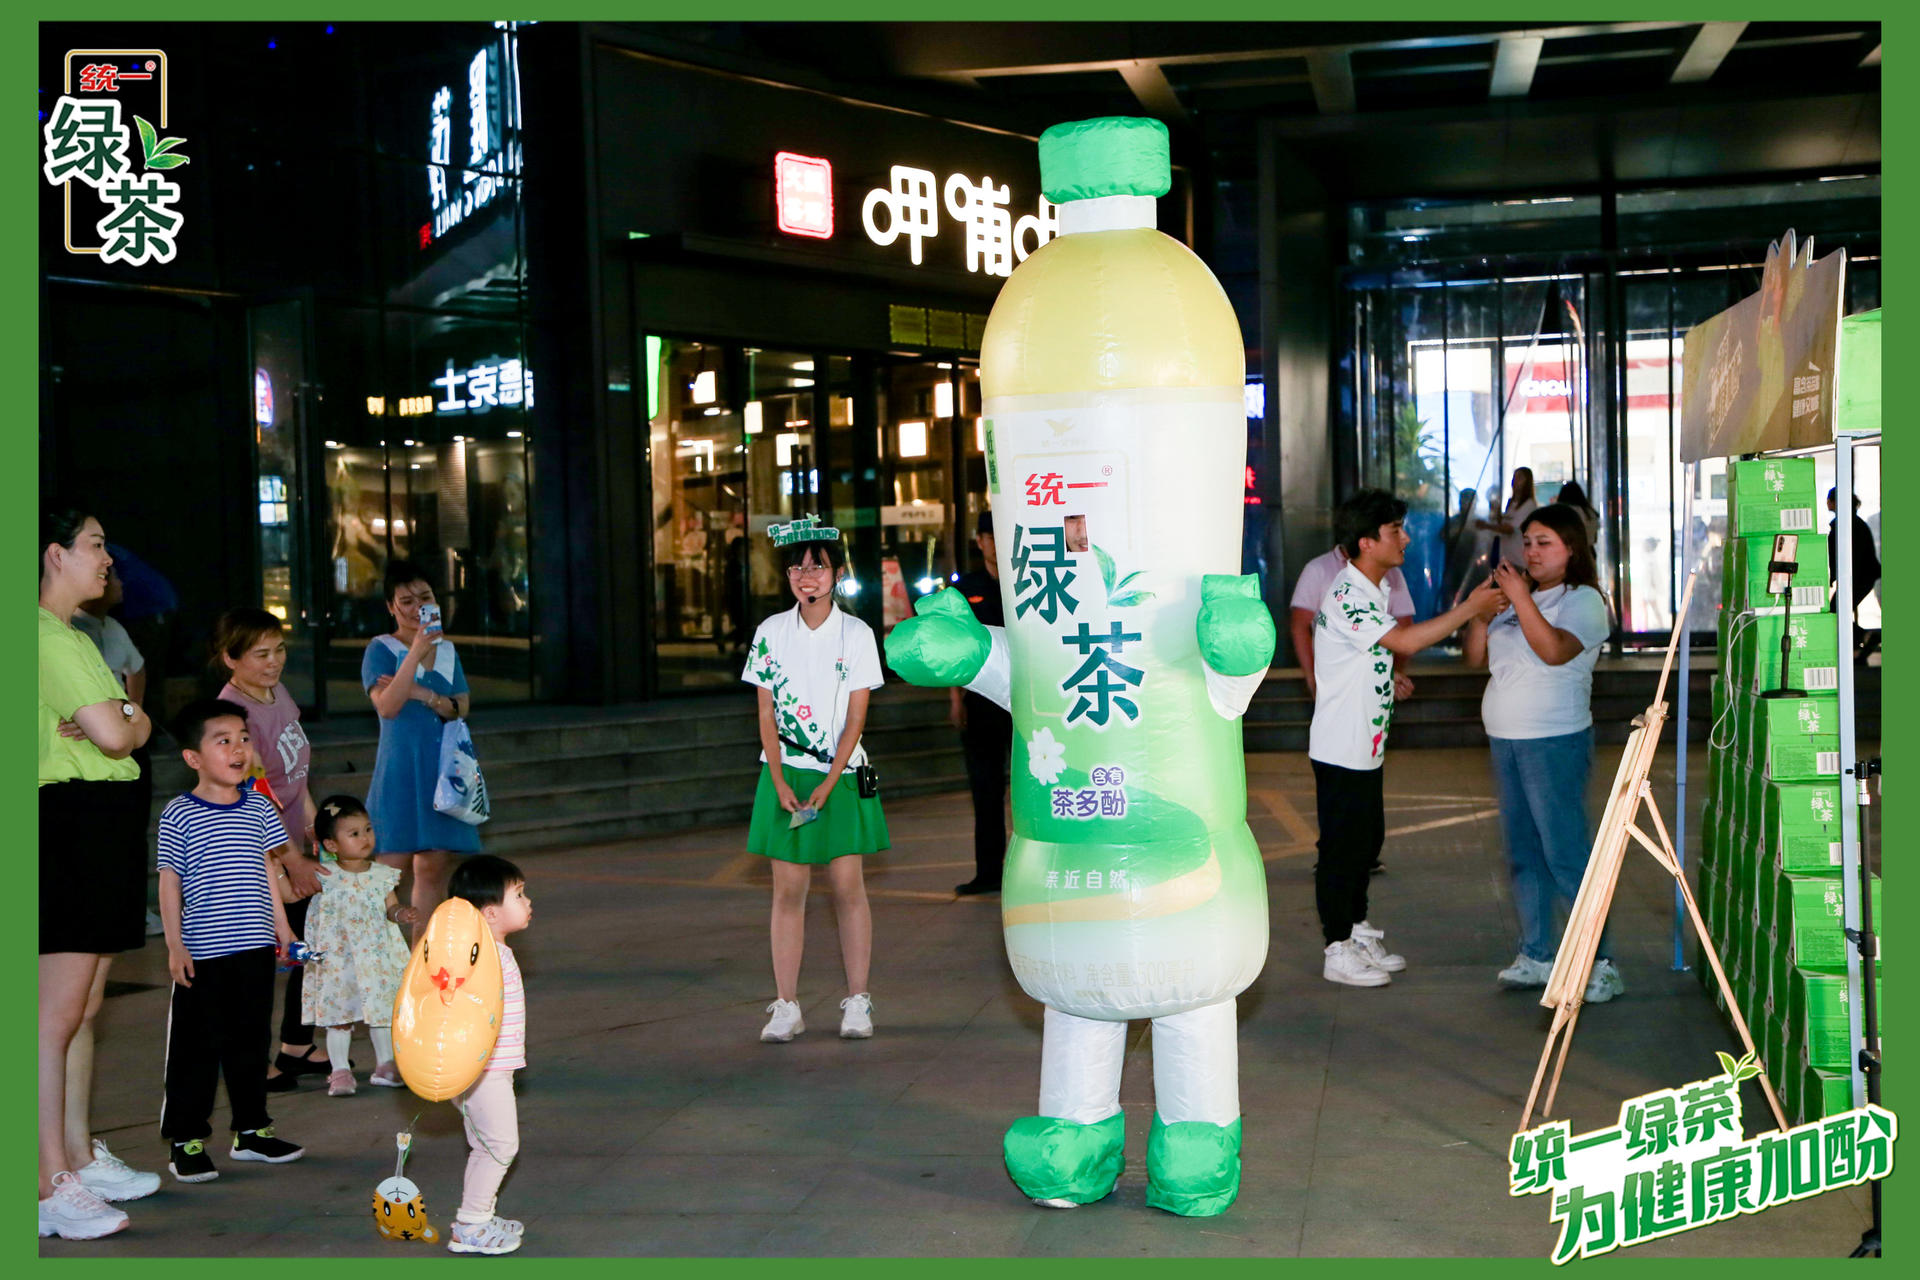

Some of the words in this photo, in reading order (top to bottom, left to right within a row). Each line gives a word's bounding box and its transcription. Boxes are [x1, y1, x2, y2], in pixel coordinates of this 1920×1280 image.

[1025, 472, 1108, 506] 统一
[1091, 767, 1125, 787] 含有
[1053, 789, 1126, 817] 茶多酚
[1045, 868, 1128, 889] 亲近自然
